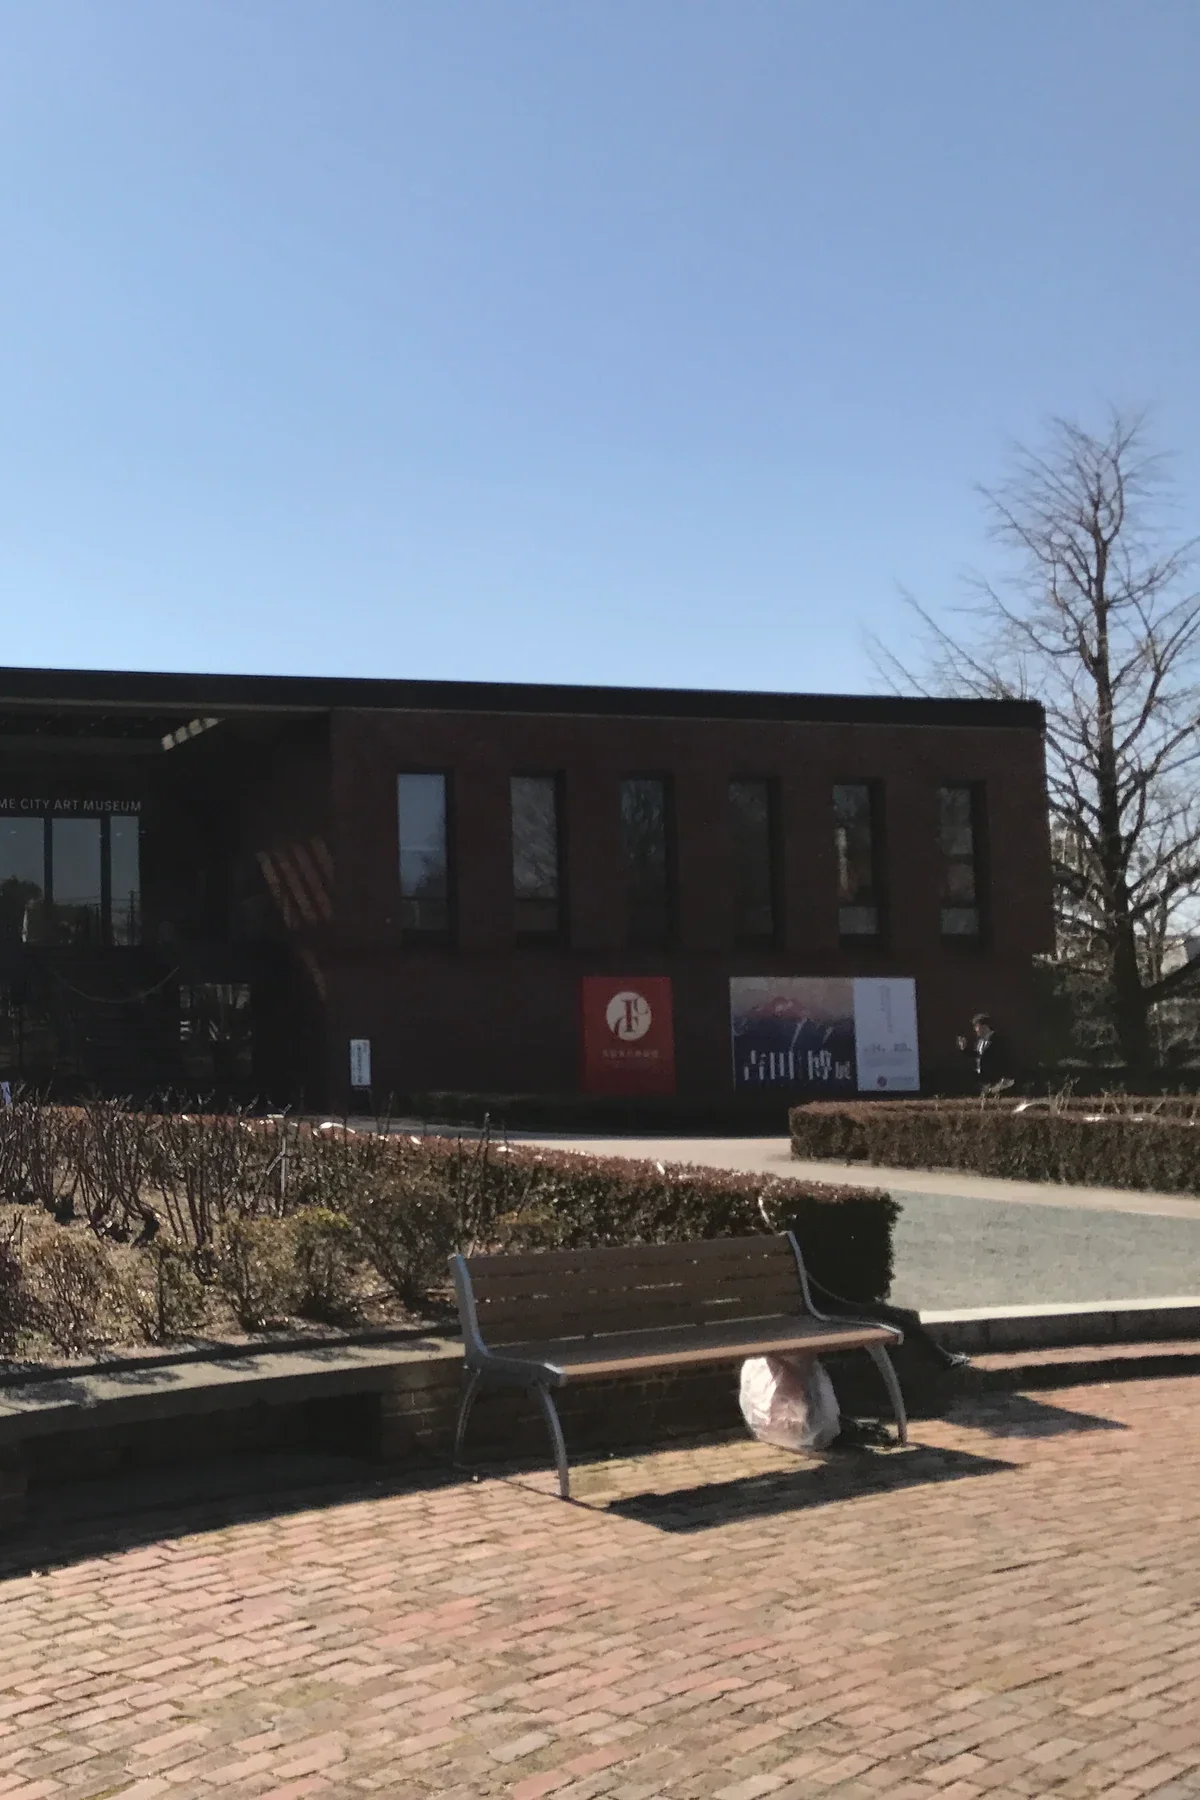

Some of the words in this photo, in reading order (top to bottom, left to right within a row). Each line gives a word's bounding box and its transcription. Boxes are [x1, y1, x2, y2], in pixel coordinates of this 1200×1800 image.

[20, 797, 50, 810] CITY
[54, 798, 79, 811] ART
[83, 799, 142, 812] MUSEUM
